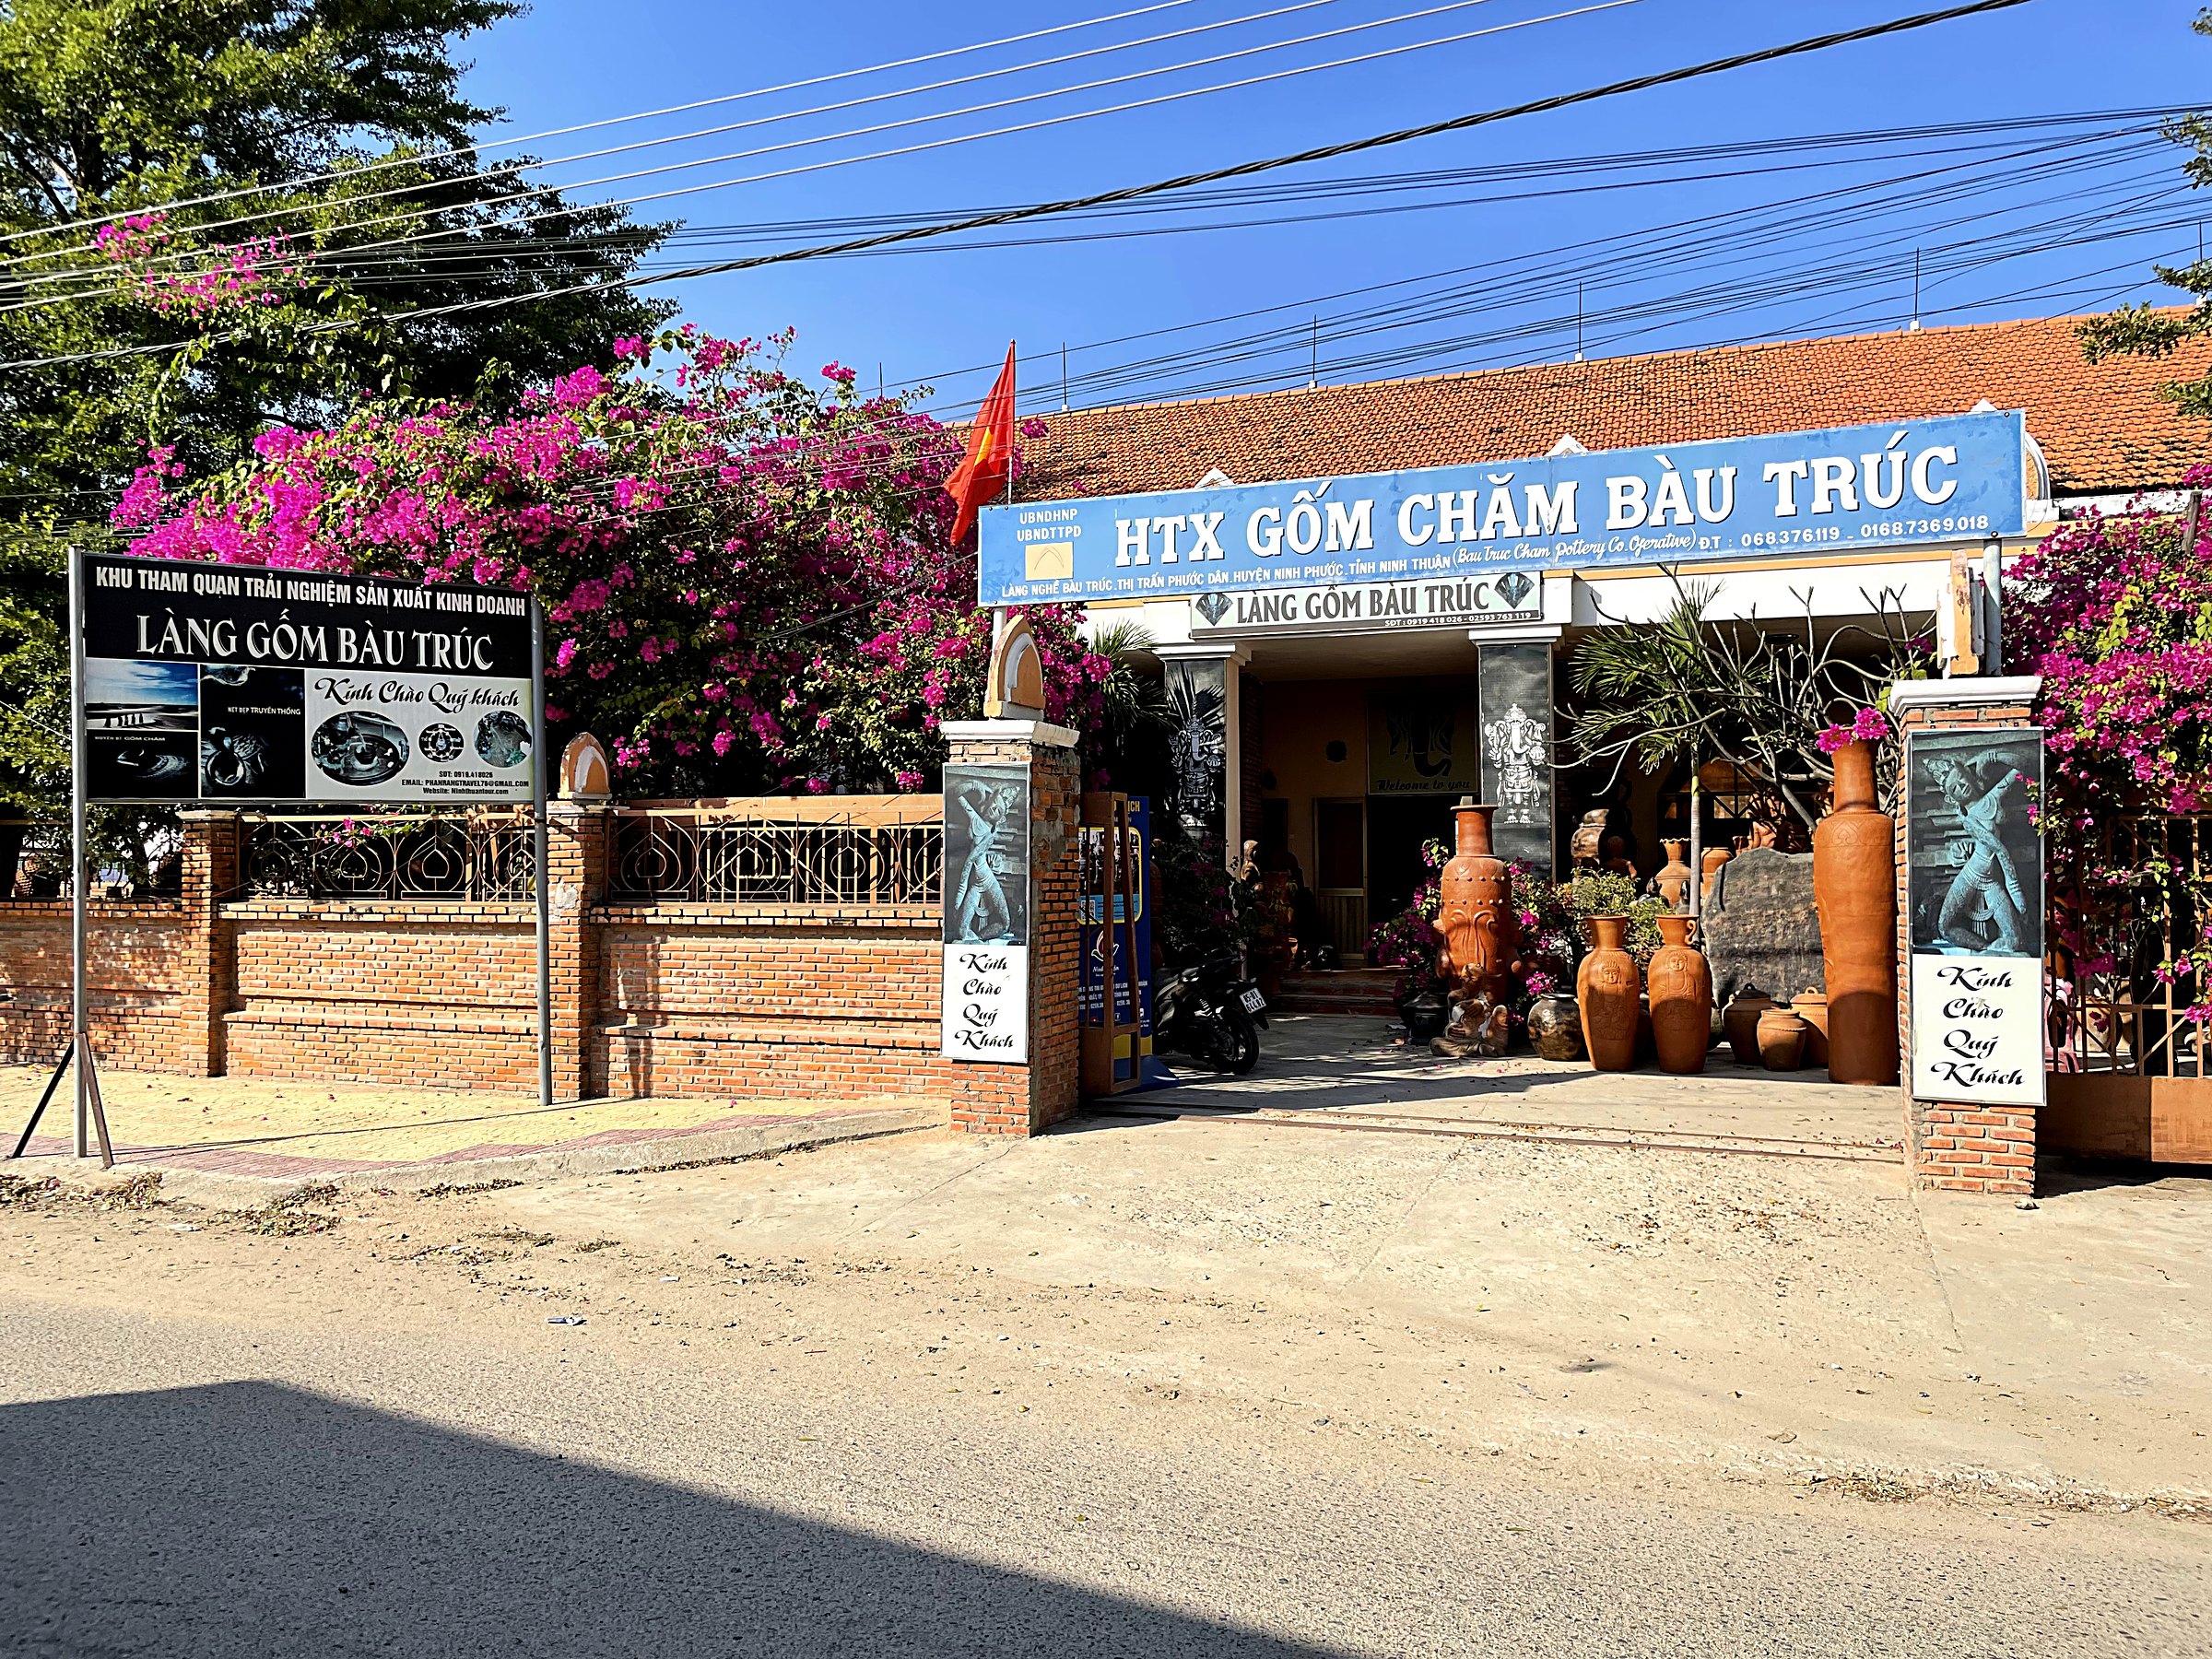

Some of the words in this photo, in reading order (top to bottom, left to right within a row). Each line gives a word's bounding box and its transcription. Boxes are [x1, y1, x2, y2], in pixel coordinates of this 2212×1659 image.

[1114, 511, 1225, 567] HTX
[1246, 481, 1375, 557] GỐM
[1396, 472, 1580, 547] CHĂM
[1605, 455, 1737, 530] BÀU
[1762, 430, 1958, 517] TRÚC
[1513, 542, 1550, 559] Cham
[1001, 582, 1029, 598] LÀNG
[1063, 580, 1083, 594] BÀU
[1137, 571, 1165, 589] TRẤN
[1168, 571, 1205, 587] PHƯỚC
[1274, 567, 1300, 580] NINH
[1380, 557, 1407, 572] NINH
[1411, 553, 1451, 571] THUẬN
[96, 566, 133, 589] KHU
[138, 570, 188, 593] THAM
[193, 573, 240, 596] QUAN
[244, 572, 282, 599] TRẢI
[287, 580, 351, 607] NGHIỆM
[356, 581, 389, 606] SẢN
[393, 583, 432, 609] XUẤT
[436, 592, 473, 613] KINH
[477, 595, 525, 617] DOANH
[1237, 590, 1298, 624] LÀNG
[1369, 582, 1417, 617] BÀU
[1424, 577, 1489, 613] TRÚC
[1407, 618, 1428, 626] 0919
[1468, 613, 1495, 622] 02593
[1497, 612, 1512, 620] 763
[136, 607, 238, 657] LÀNG
[246, 608, 328, 662] GỐM
[336, 620, 405, 665] BÀU
[412, 627, 494, 671] TRÚC
[314, 677, 374, 706] Kính
[378, 680, 424, 703] Chào
[428, 682, 469, 714] Quý
[468, 688, 520, 707] khách
[1376, 779, 1430, 791] Welcome
[1432, 779, 1444, 789] to
[1448, 781, 1470, 791] you
[959, 953, 1007, 973] Kính
[962, 978, 1002, 995] Chào
[1937, 966, 2015, 991] Kính
[962, 1003, 998, 1028] Quý
[1942, 997, 2004, 1019] Chào
[954, 1030, 1014, 1050] Khách
[1943, 1029, 1999, 1059] Quý
[1930, 1061, 2025, 1088] Khách
